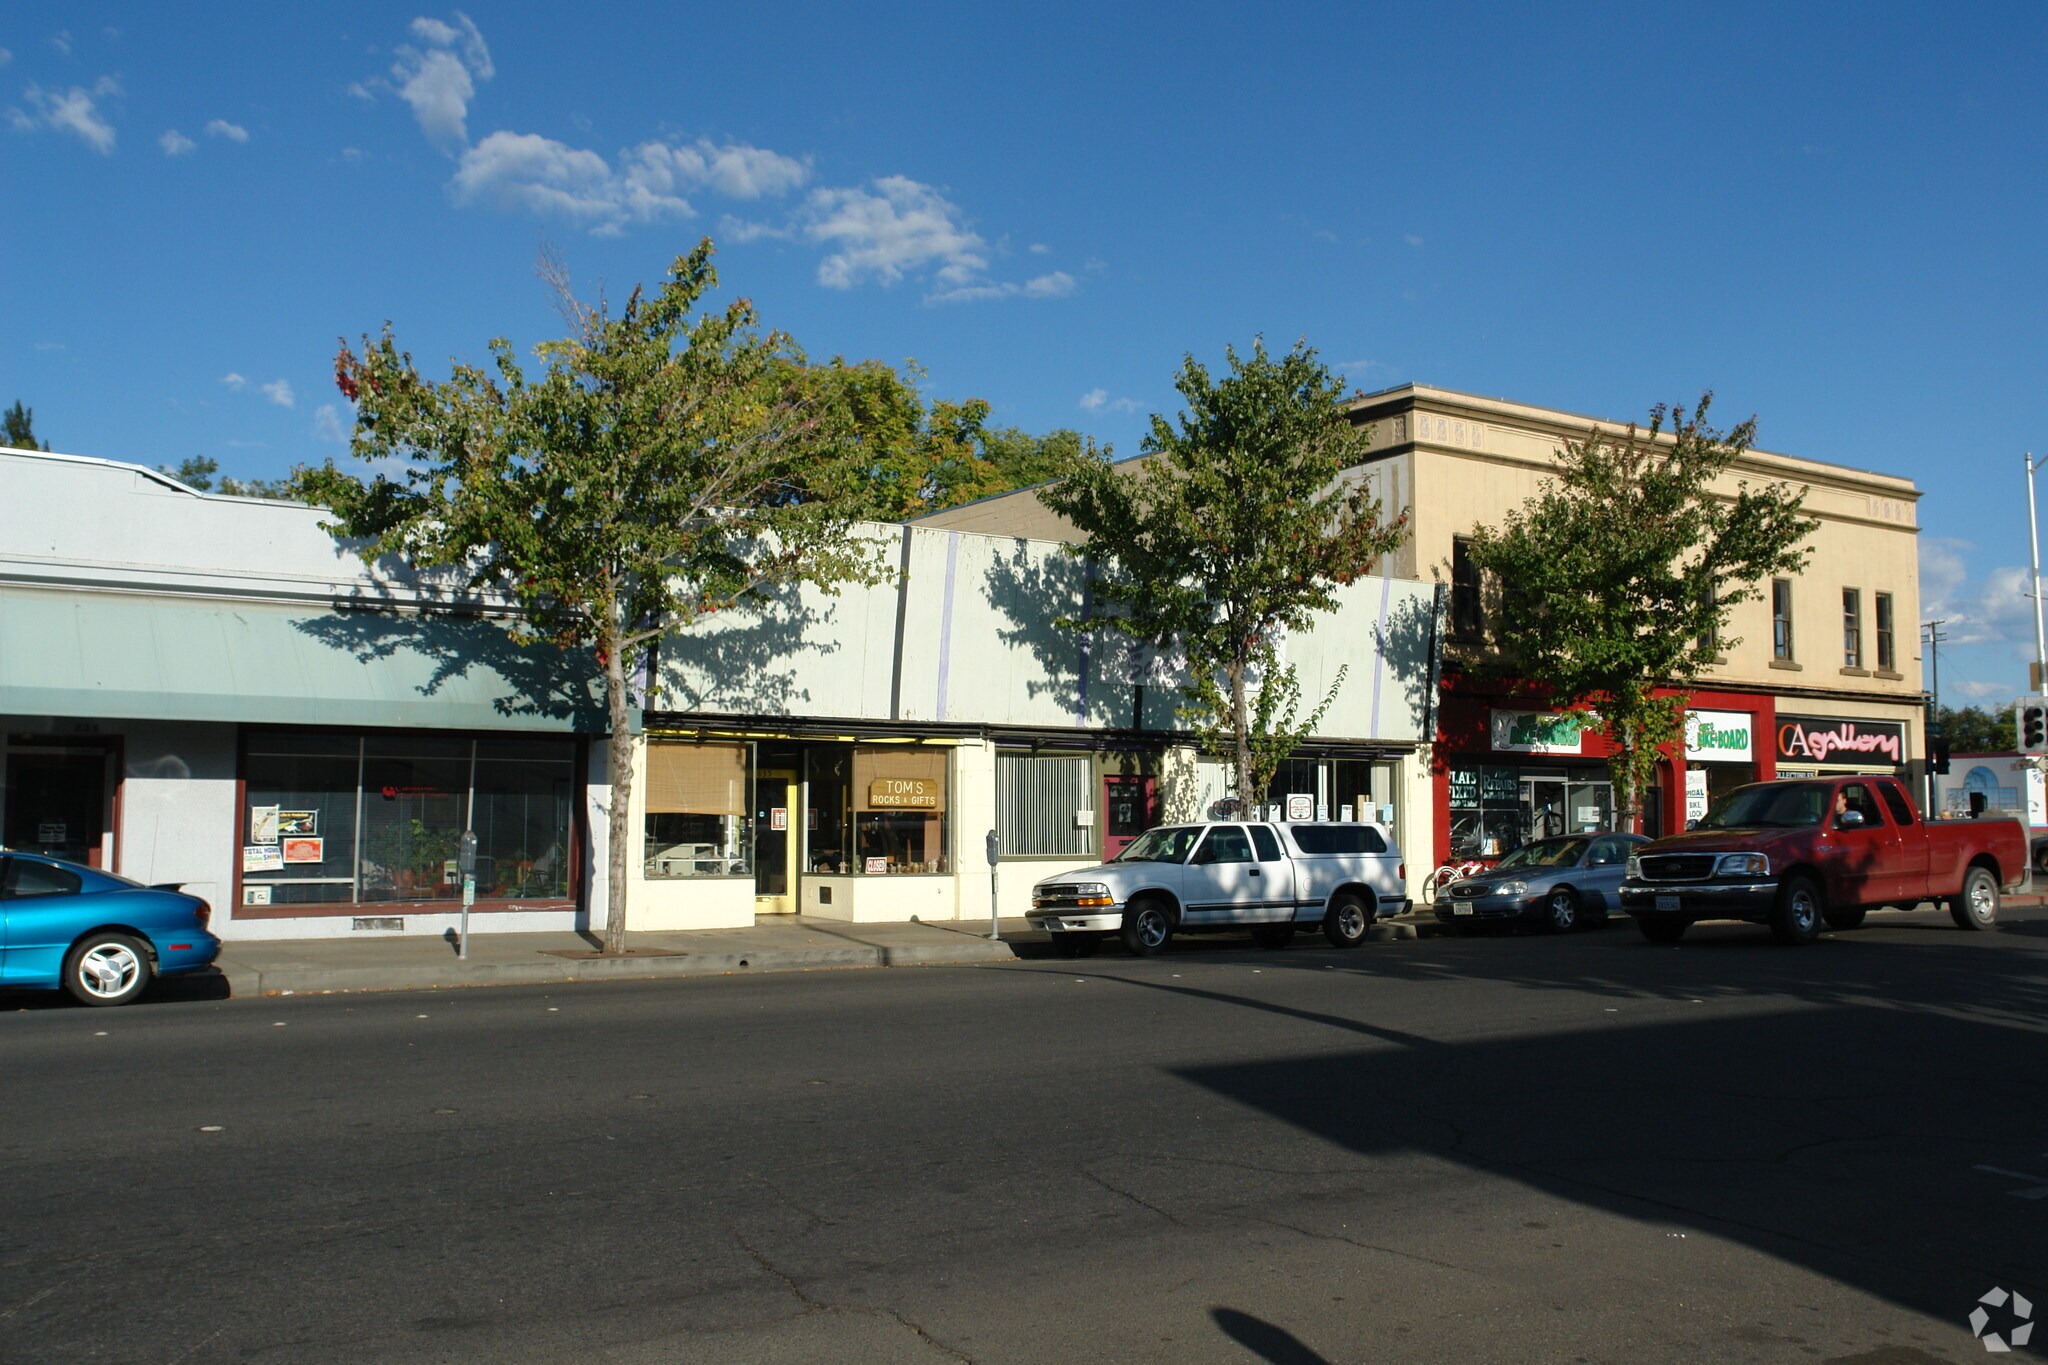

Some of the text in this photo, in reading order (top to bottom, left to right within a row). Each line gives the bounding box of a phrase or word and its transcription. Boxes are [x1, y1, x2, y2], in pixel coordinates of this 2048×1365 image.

[886, 780, 924, 795] TOM'S
[1483, 775, 1517, 791] REPAIRS
[872, 795, 901, 805] ROCKS
[911, 796, 936, 805] GIFTS
[868, 859, 885, 872] CLOSED
